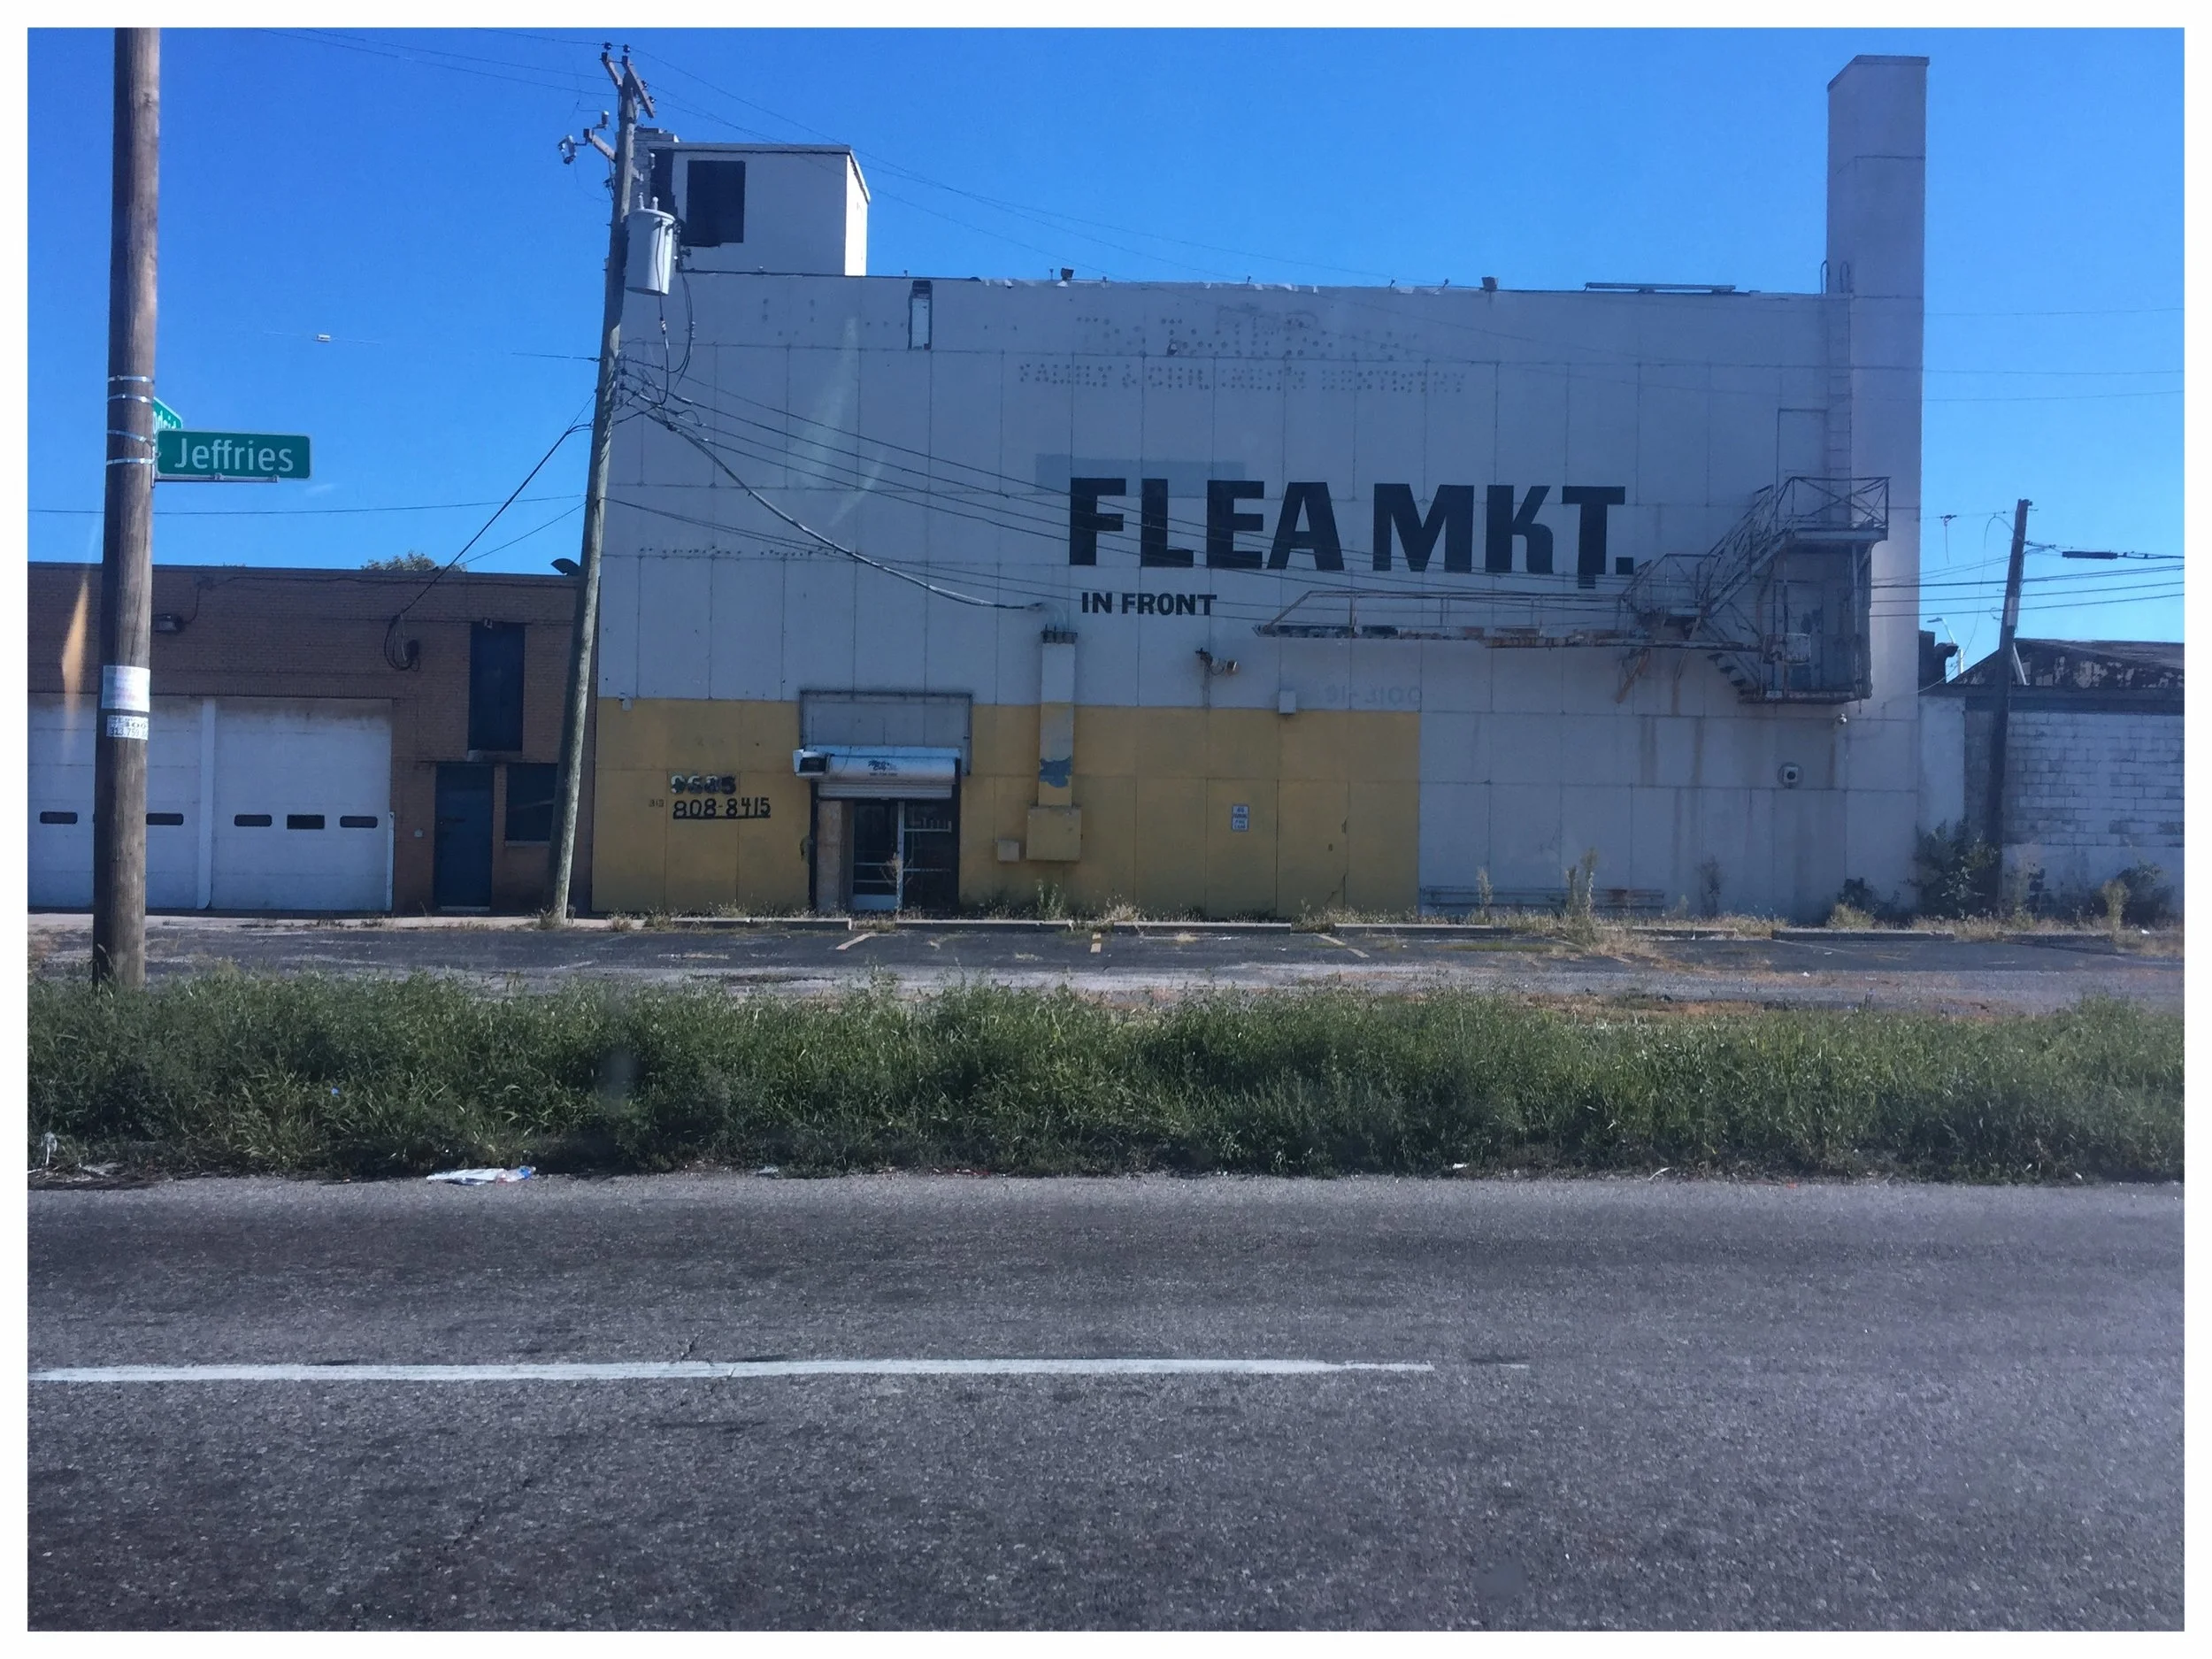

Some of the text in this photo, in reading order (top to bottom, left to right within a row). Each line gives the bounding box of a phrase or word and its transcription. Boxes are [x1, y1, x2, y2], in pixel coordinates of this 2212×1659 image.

[174, 437, 294, 472] Jeffries
[1069, 477, 1634, 589] FLEA MKT.
[1081, 591, 1217, 617] IN FRONT
[672, 796, 772, 818] 808-8415
